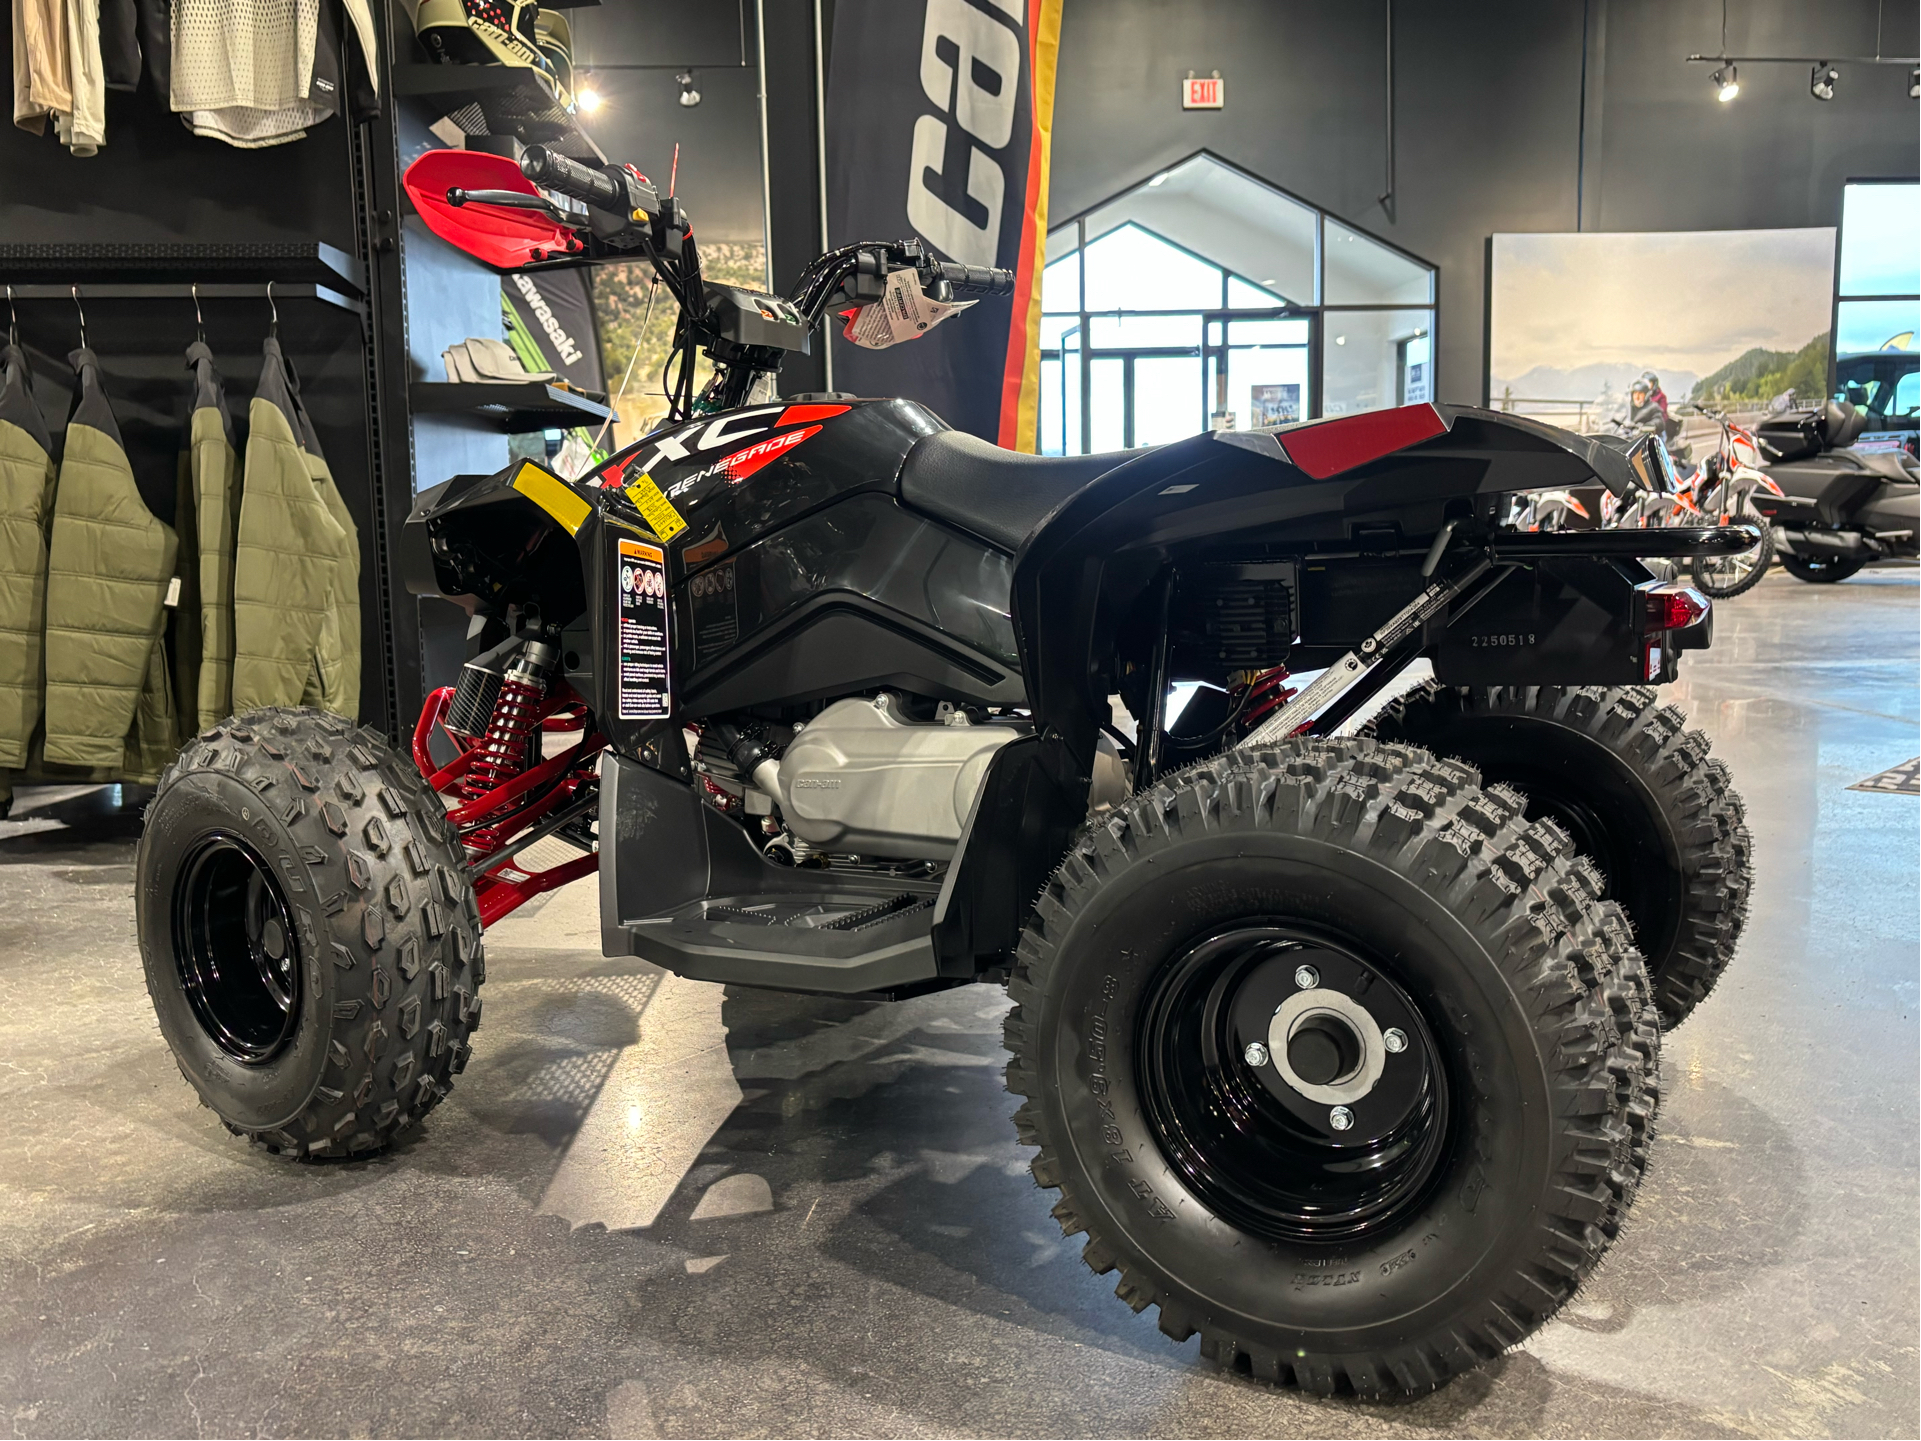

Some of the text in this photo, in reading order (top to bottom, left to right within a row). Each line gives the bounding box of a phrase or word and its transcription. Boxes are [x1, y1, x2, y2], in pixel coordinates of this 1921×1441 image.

[468, 16, 535, 64] can-am
[1191, 80, 1218, 104] EXIT
[907, 0, 1025, 268] ca
[512, 274, 583, 366] awasaki
[663, 431, 806, 500] RENEGADE
[1471, 634, 1535, 647] 2250518
[796, 778, 841, 789] can-am
